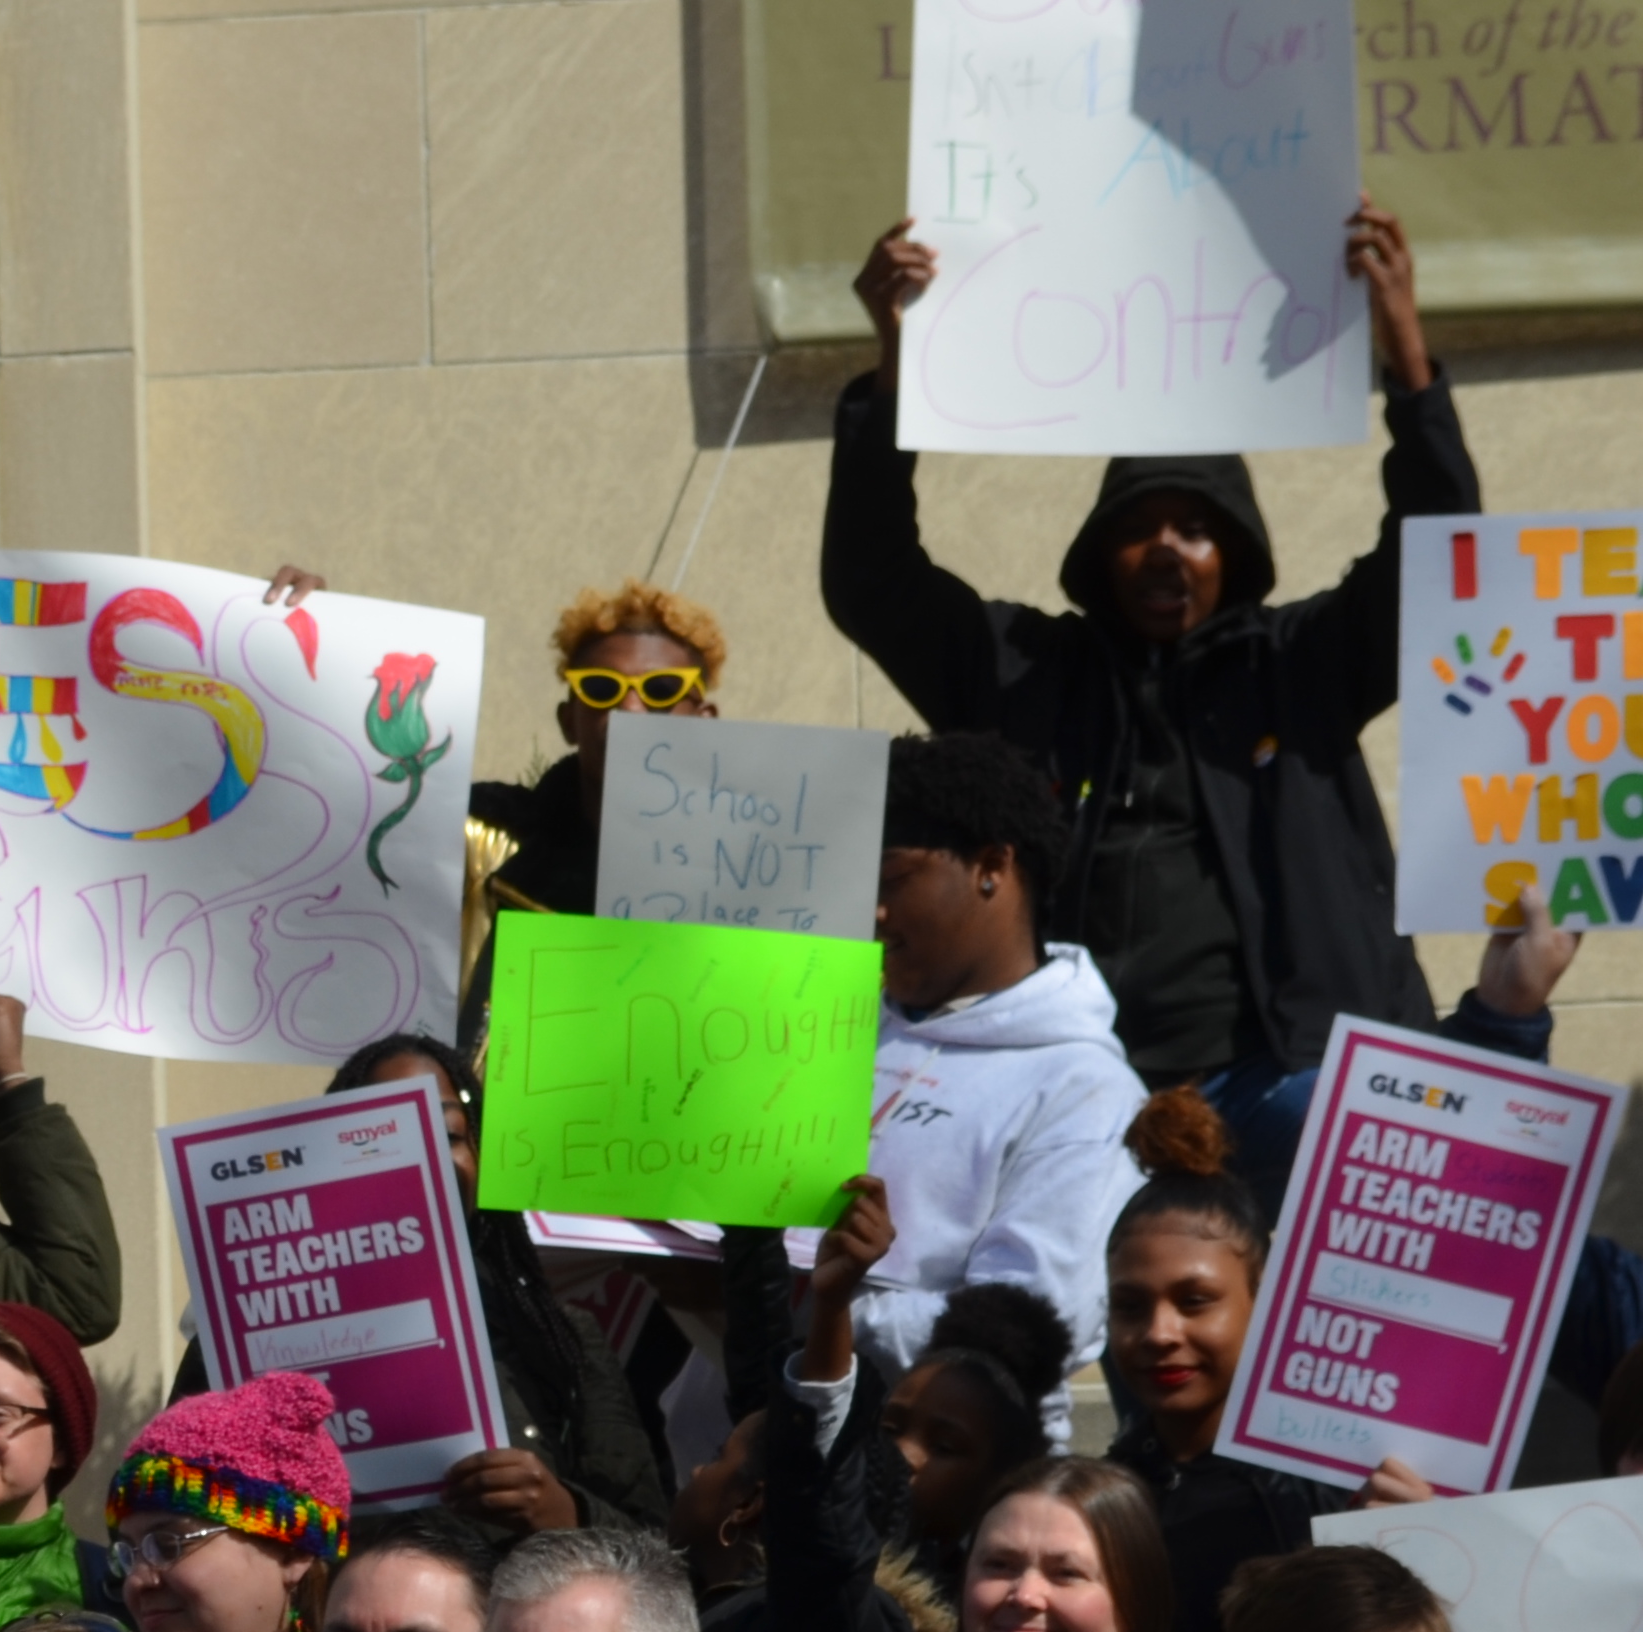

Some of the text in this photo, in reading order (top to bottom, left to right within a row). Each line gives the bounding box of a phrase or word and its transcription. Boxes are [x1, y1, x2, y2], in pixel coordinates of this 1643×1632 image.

[1462, 0, 1637, 77] of the
[1451, 526, 1643, 600] I TE
[640, 743, 807, 834] School
[715, 833, 825, 890] NOT
[1368, 1074, 1465, 1115] GLSEN
[210, 1119, 398, 1182] GLSEN smyal
[1348, 1122, 1450, 1180] ARM
[224, 1194, 314, 1245] ARM
[1340, 1167, 1542, 1250] TEACHERS
[227, 1216, 425, 1286] TEACHERS
[1327, 1211, 1436, 1272] WITH
[236, 1277, 341, 1328] WITH
[1294, 1306, 1383, 1360] NOT
[1283, 1352, 1400, 1412] GUNS
